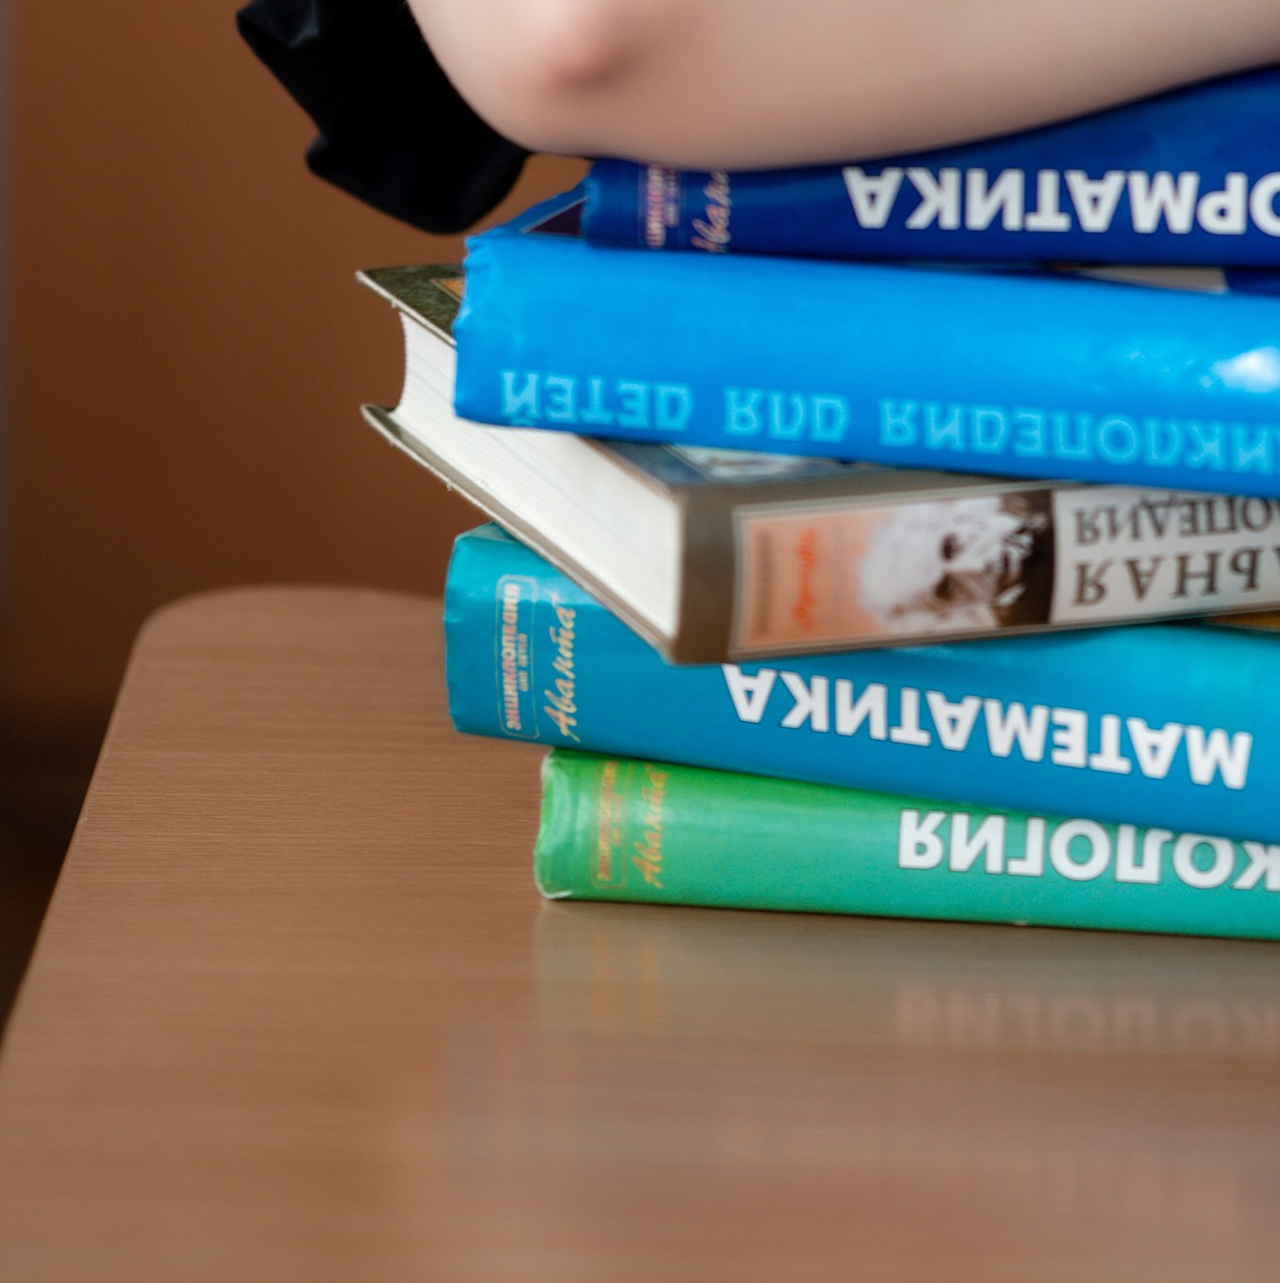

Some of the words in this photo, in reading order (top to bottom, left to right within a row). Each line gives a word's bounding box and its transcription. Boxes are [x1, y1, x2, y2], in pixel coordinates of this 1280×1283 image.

[500, 371, 693, 429] ДЕТЕЙ
[724, 386, 847, 443] ДЛЯ
[721, 663, 1252, 790] МАТЕМАТИКА
